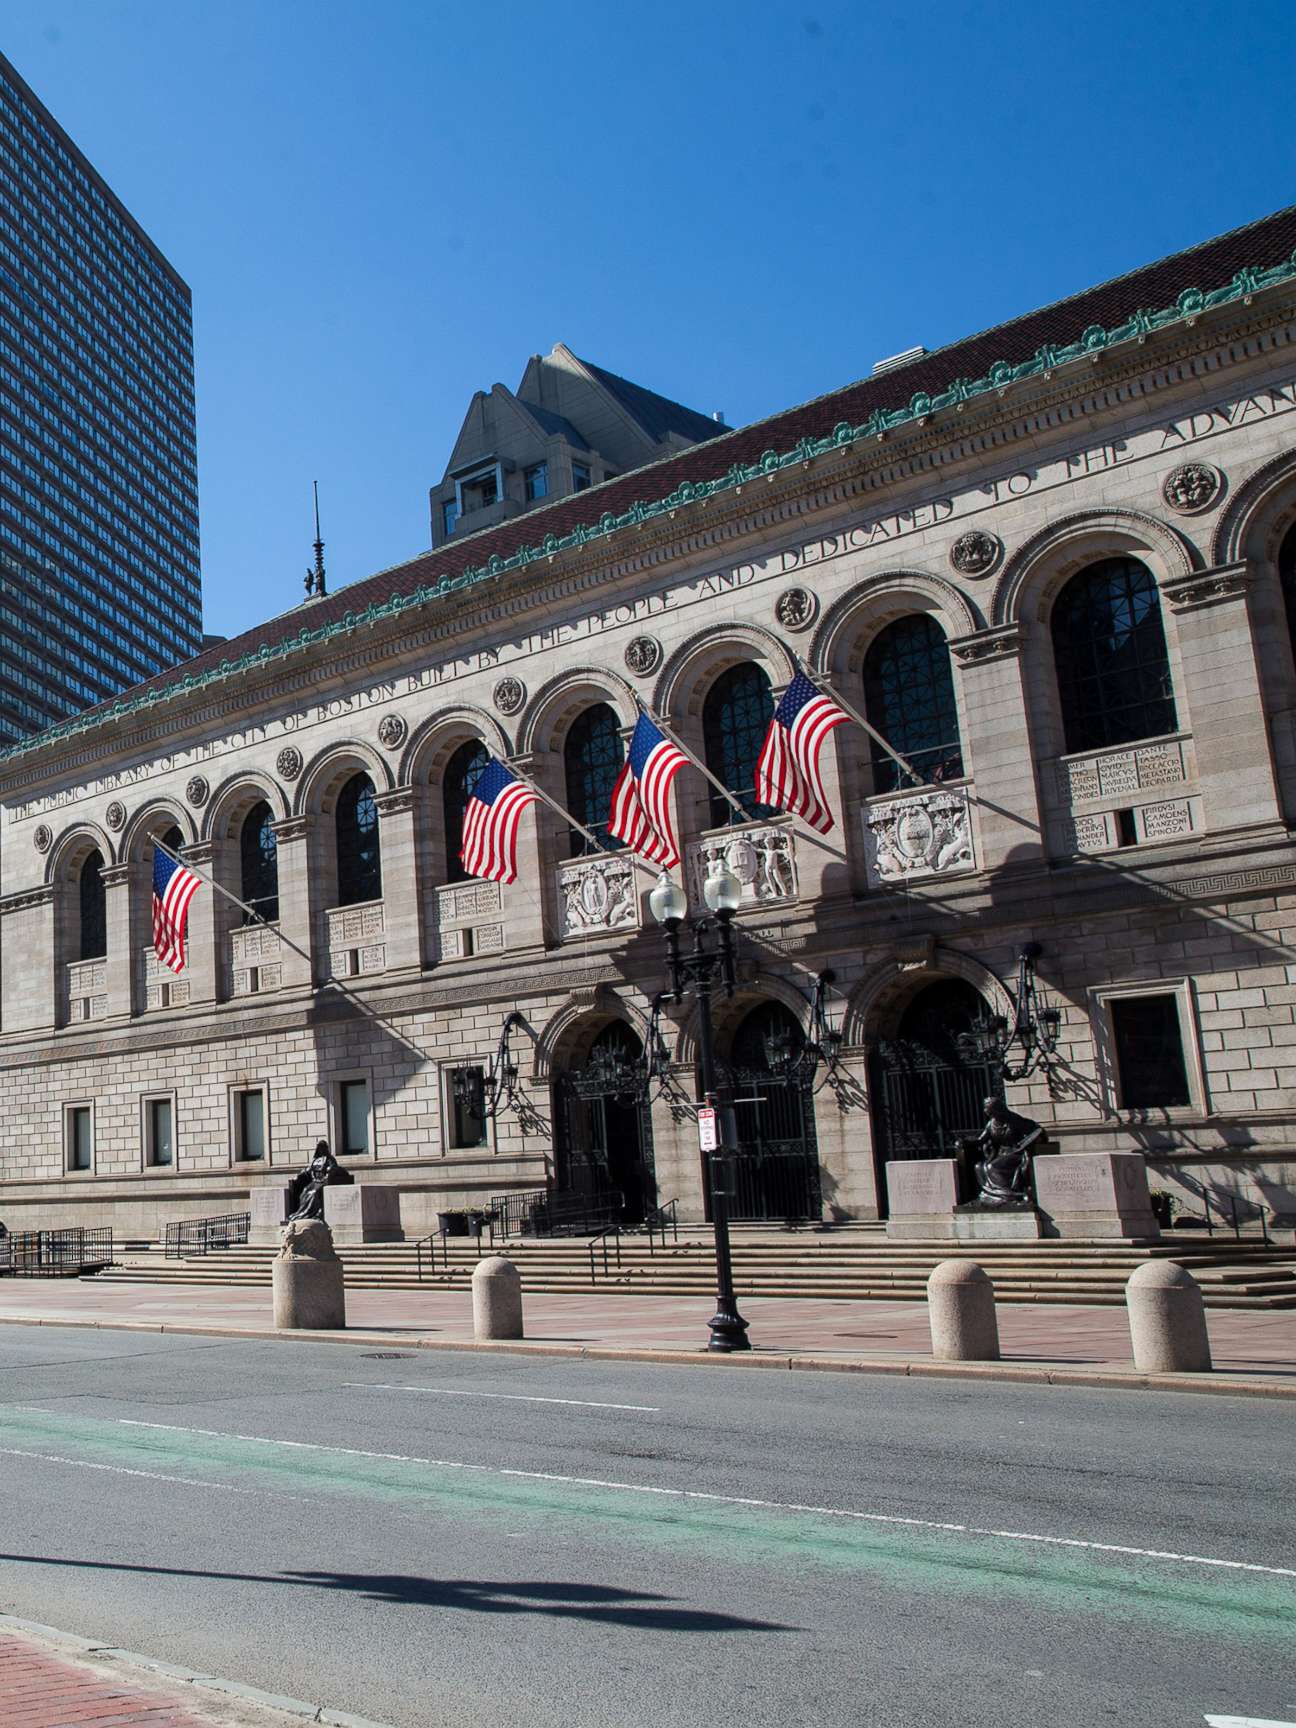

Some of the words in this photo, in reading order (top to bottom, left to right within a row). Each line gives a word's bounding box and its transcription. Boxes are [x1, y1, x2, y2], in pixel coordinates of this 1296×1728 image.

[12, 801, 35, 820] THE
[43, 784, 86, 811] PUBLIC
[95, 759, 154, 793] LIBRARY
[160, 756, 181, 771] OF
[190, 738, 222, 761] THE
[231, 722, 269, 750] CITY
[284, 711, 306, 731] OF
[316, 681, 397, 721] BOSTON
[408, 659, 461, 692] BUILT
[478, 646, 503, 669] BY
[526, 628, 573, 653] THE
[588, 594, 678, 633] PEOPLE
[699, 563, 755, 598] AND
[780, 498, 954, 571] DEDICATED
[987, 471, 1032, 501] TO
[1057, 437, 1135, 479] THE
[1137, 746, 1168, 756] DANTE
[1099, 753, 1131, 764] HORACE
[1139, 753, 1168, 763] TASSO
[1142, 775, 1181, 788] LEOPARDI
[1146, 809, 1188, 820] CAMOENS
[1147, 817, 1186, 829] MANZONI
[1148, 826, 1184, 838] SPINOZA
